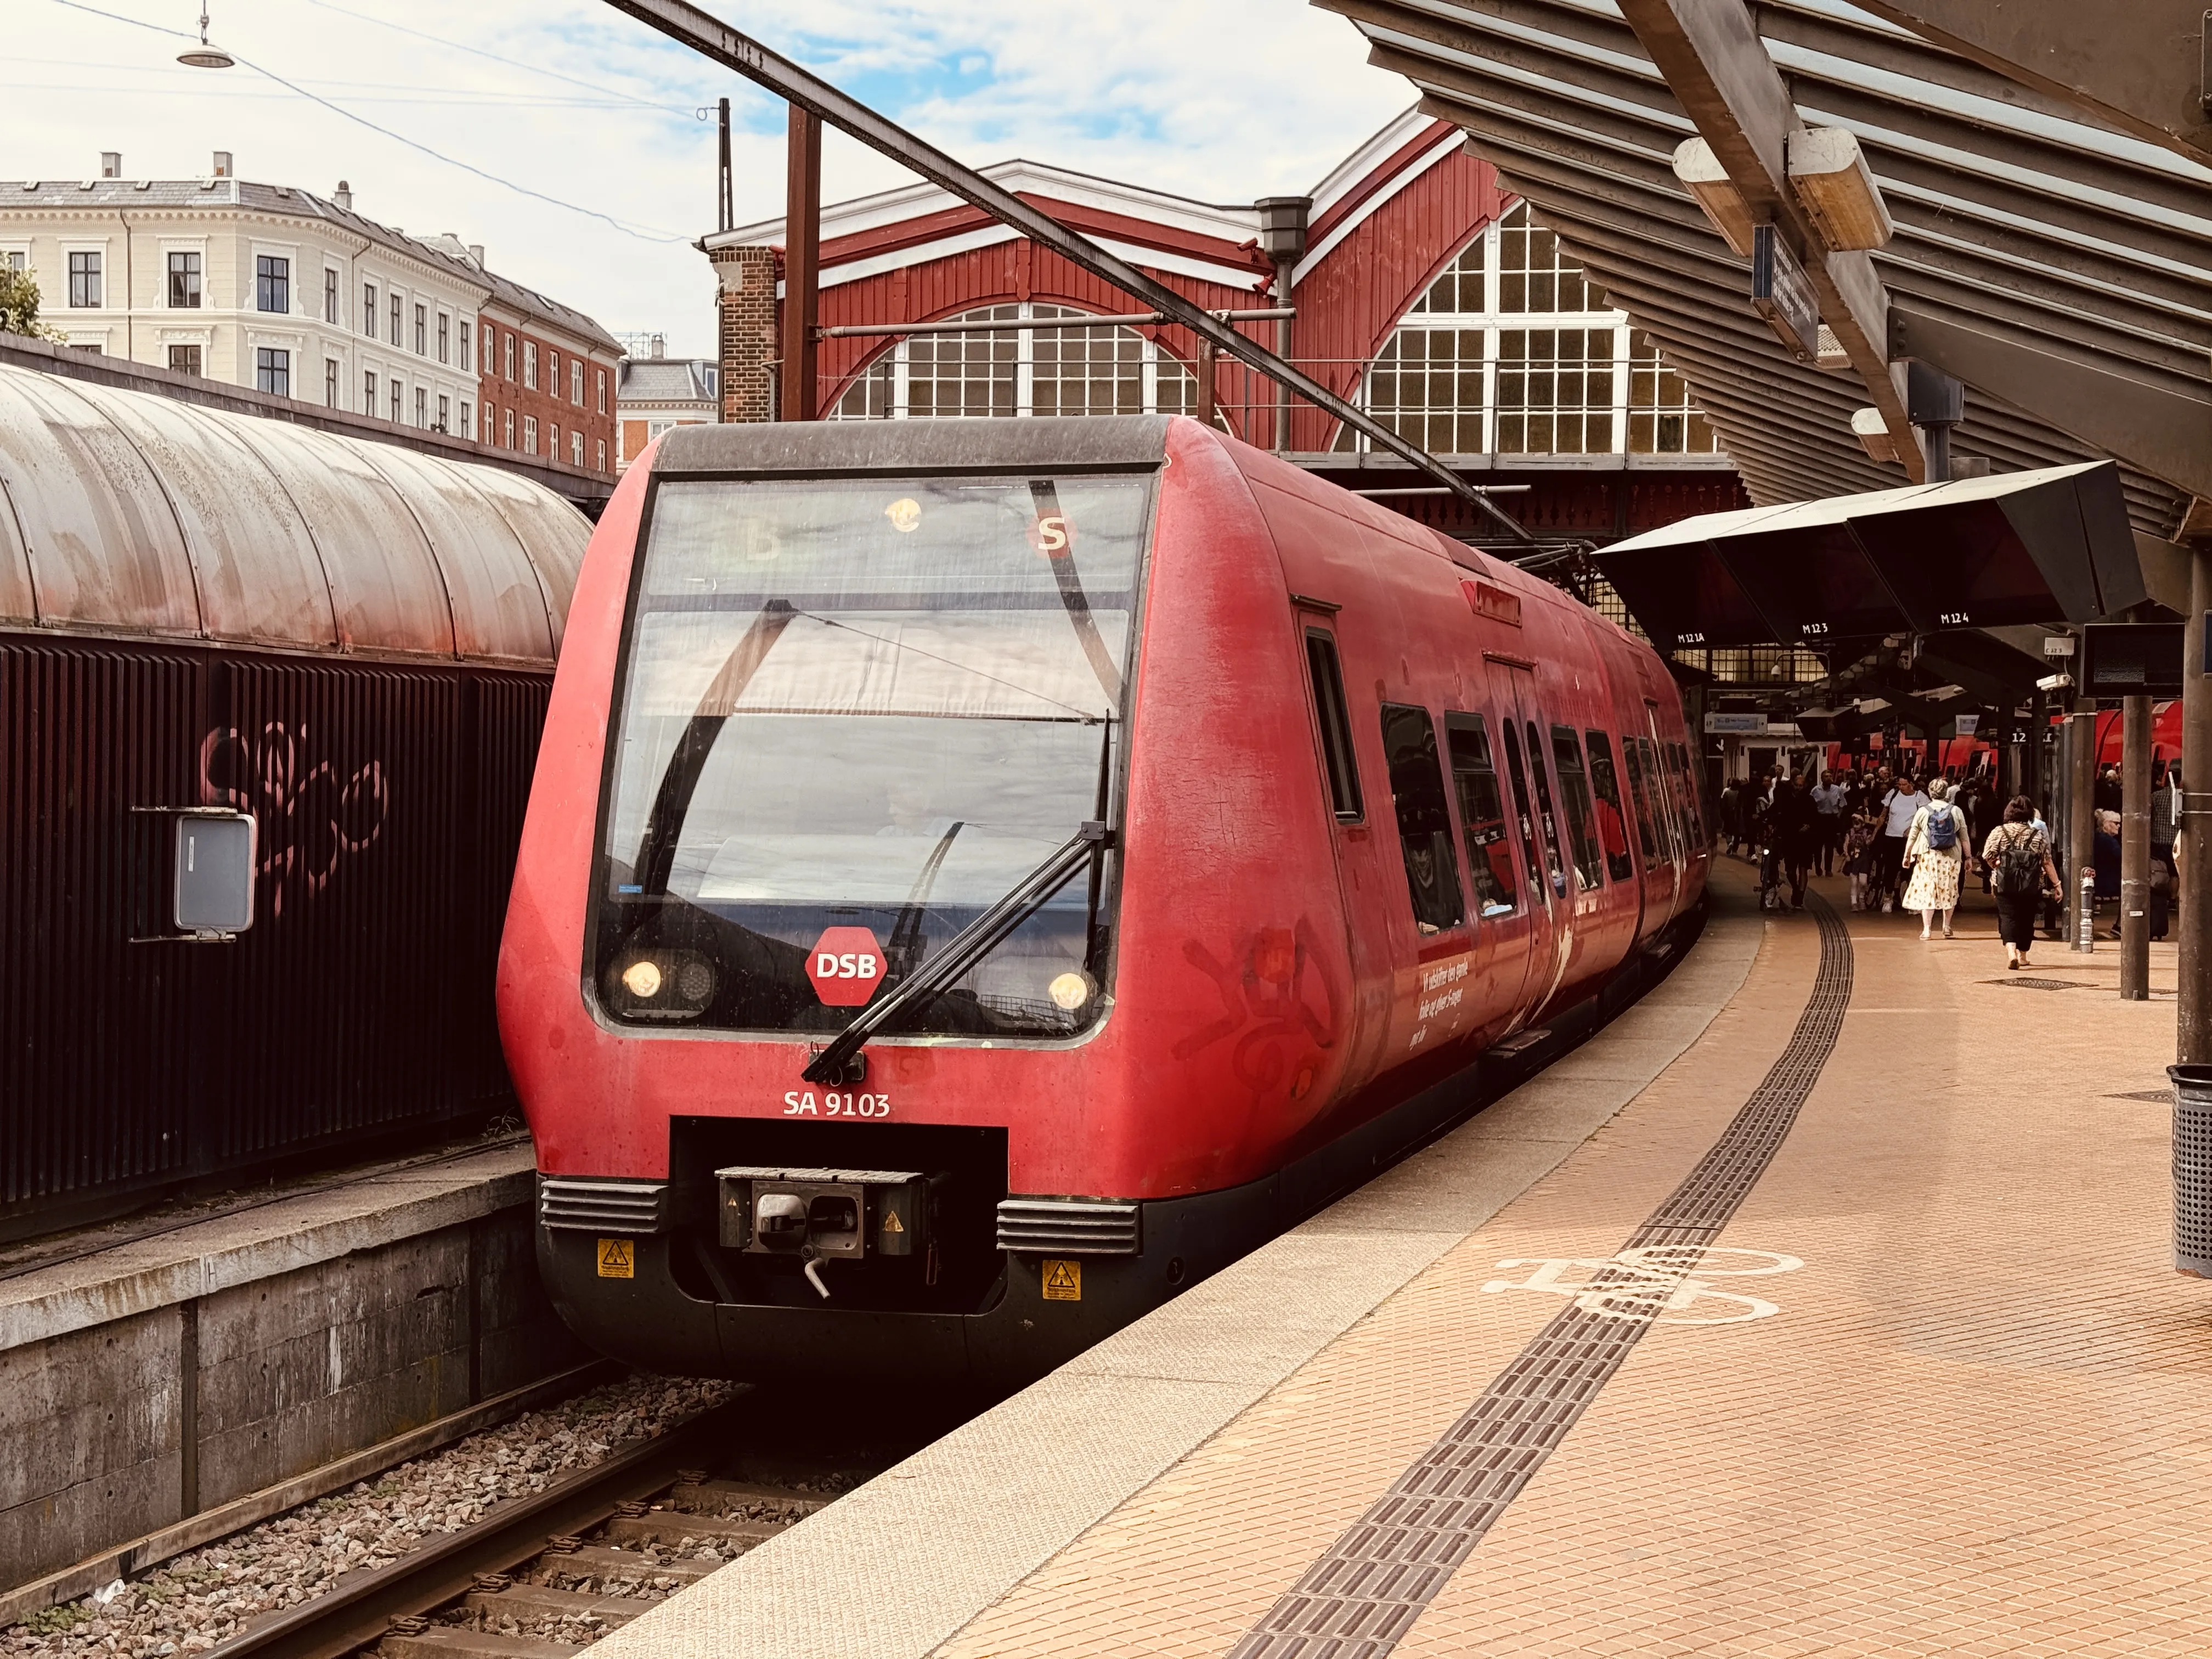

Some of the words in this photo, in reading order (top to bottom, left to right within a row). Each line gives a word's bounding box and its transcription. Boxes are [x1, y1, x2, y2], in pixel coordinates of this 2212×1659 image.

[1038, 517, 1066, 550] S
[2012, 732, 2026, 742] 12
[816, 953, 877, 979] DSB
[783, 1091, 818, 1115] SA
[825, 1092, 890, 1117] 9103
